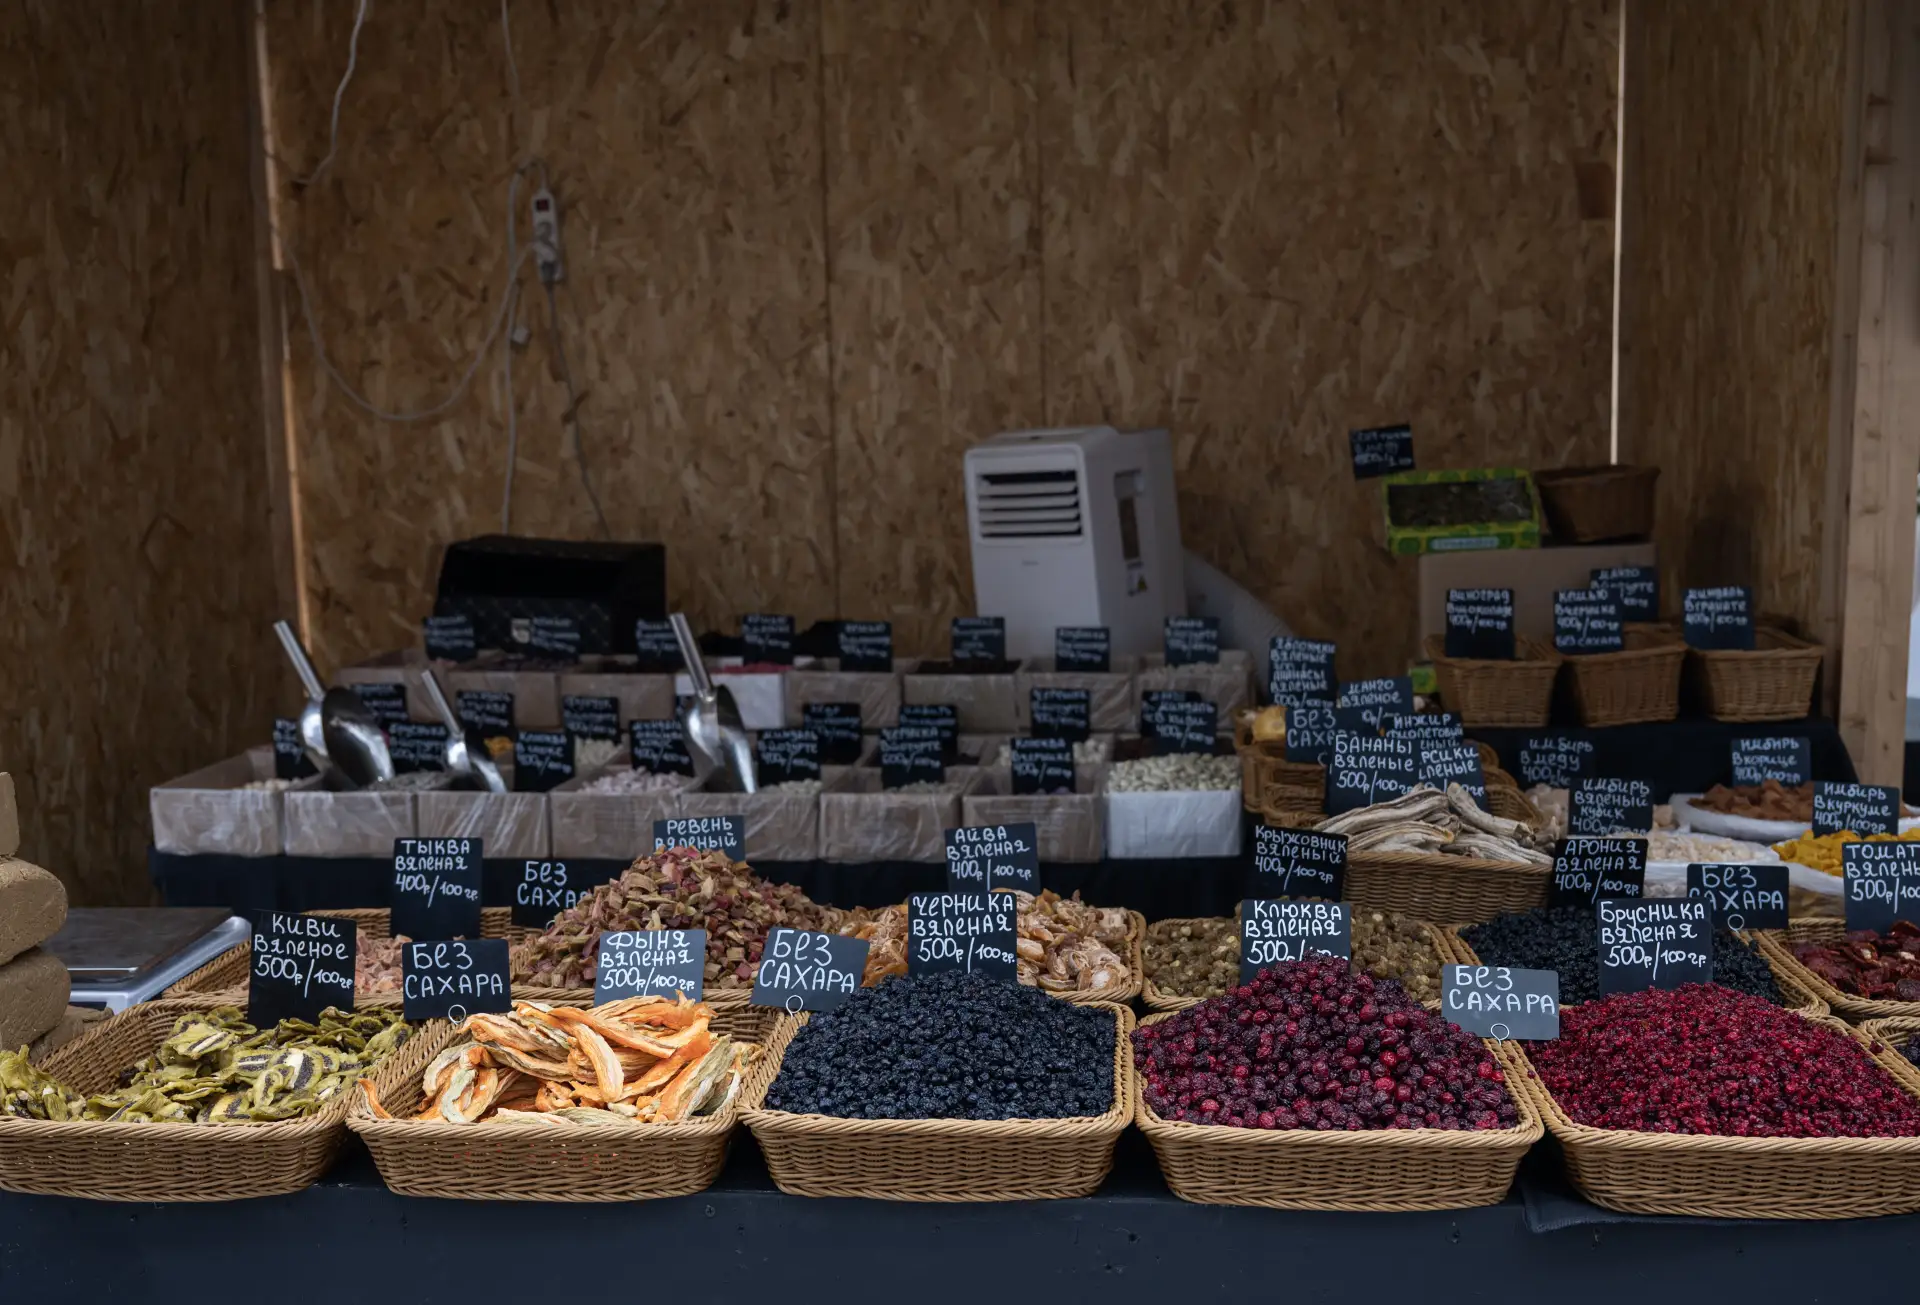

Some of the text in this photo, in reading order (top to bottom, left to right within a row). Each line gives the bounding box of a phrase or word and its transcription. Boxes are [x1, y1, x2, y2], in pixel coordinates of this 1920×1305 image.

[1335, 734, 1412, 755] БАНАНЫ
[1335, 753, 1414, 772] ВЯЛЕНЫЕ
[667, 817, 733, 835] РЕВЕНЬ
[954, 825, 1008, 844] АЙВА
[401, 839, 470, 855] ТЫКВА
[946, 839, 1031, 861] ВЯЛЕНАЯ
[1565, 839, 1641, 855] АРОНИЯ
[395, 855, 469, 871] ВЯЛЕНАЯ
[525, 860, 567, 888] БЕЗ
[1555, 856, 1643, 872] ВЯЛЕНАЯ
[1702, 865, 1757, 888] БЕЗ
[912, 893, 1013, 917] ЧЕРНИКА
[1254, 900, 1342, 920] КЛЮКВА
[1600, 901, 1705, 930] БРУСНИКА
[272, 913, 342, 937] КИВИ
[913, 913, 1012, 937] ВЯЛЕНАЯ
[1245, 918, 1342, 938] ВЯЛЕНАЯ
[1601, 923, 1698, 944] ВЯЛЕНАЯ
[254, 934, 350, 960] ВЯЛЕНОЕ
[412, 942, 473, 969] БЕЗ
[773, 929, 833, 967] БЕЗ
[600, 949, 695, 968] ВЯЛЕНАЯ
[405, 973, 504, 999] САХАРА
[760, 959, 855, 993] САХАРА
[1455, 965, 1513, 991] БЕЗ
[1448, 988, 1557, 1015] САХАРА
